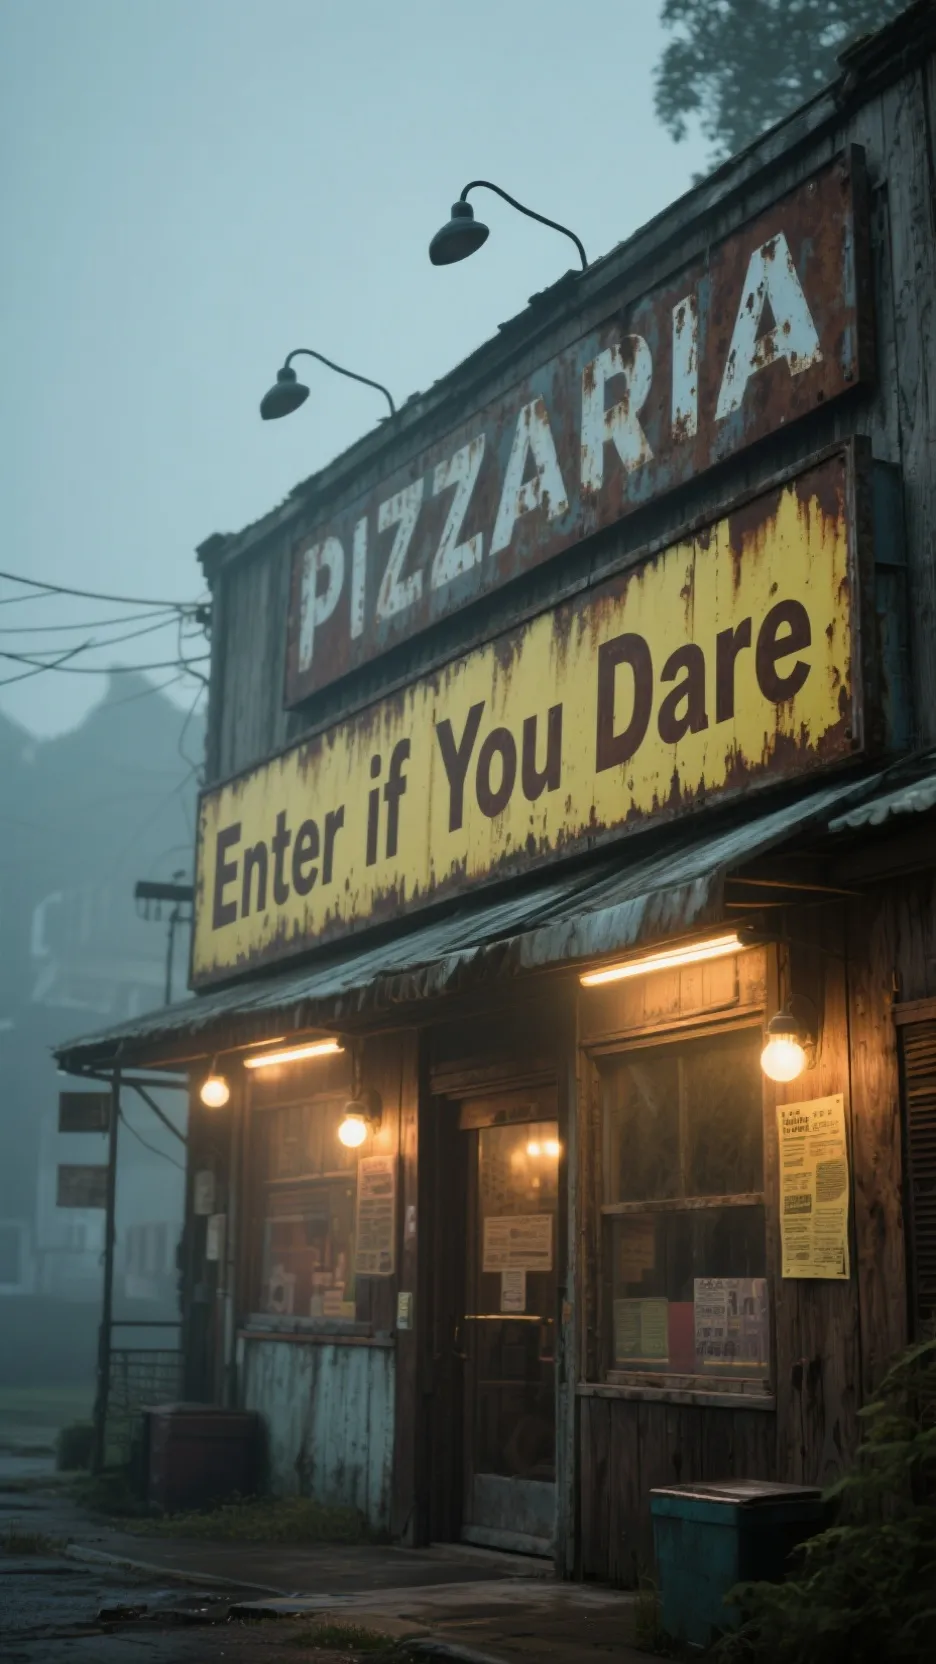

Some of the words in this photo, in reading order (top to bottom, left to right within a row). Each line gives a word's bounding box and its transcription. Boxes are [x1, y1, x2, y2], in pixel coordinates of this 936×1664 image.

[298, 231, 824, 674] PIZZARIA
[212, 804, 345, 931] Enter
[366, 738, 411, 867] if
[436, 700, 563, 833] You
[595, 599, 812, 774] Dare
